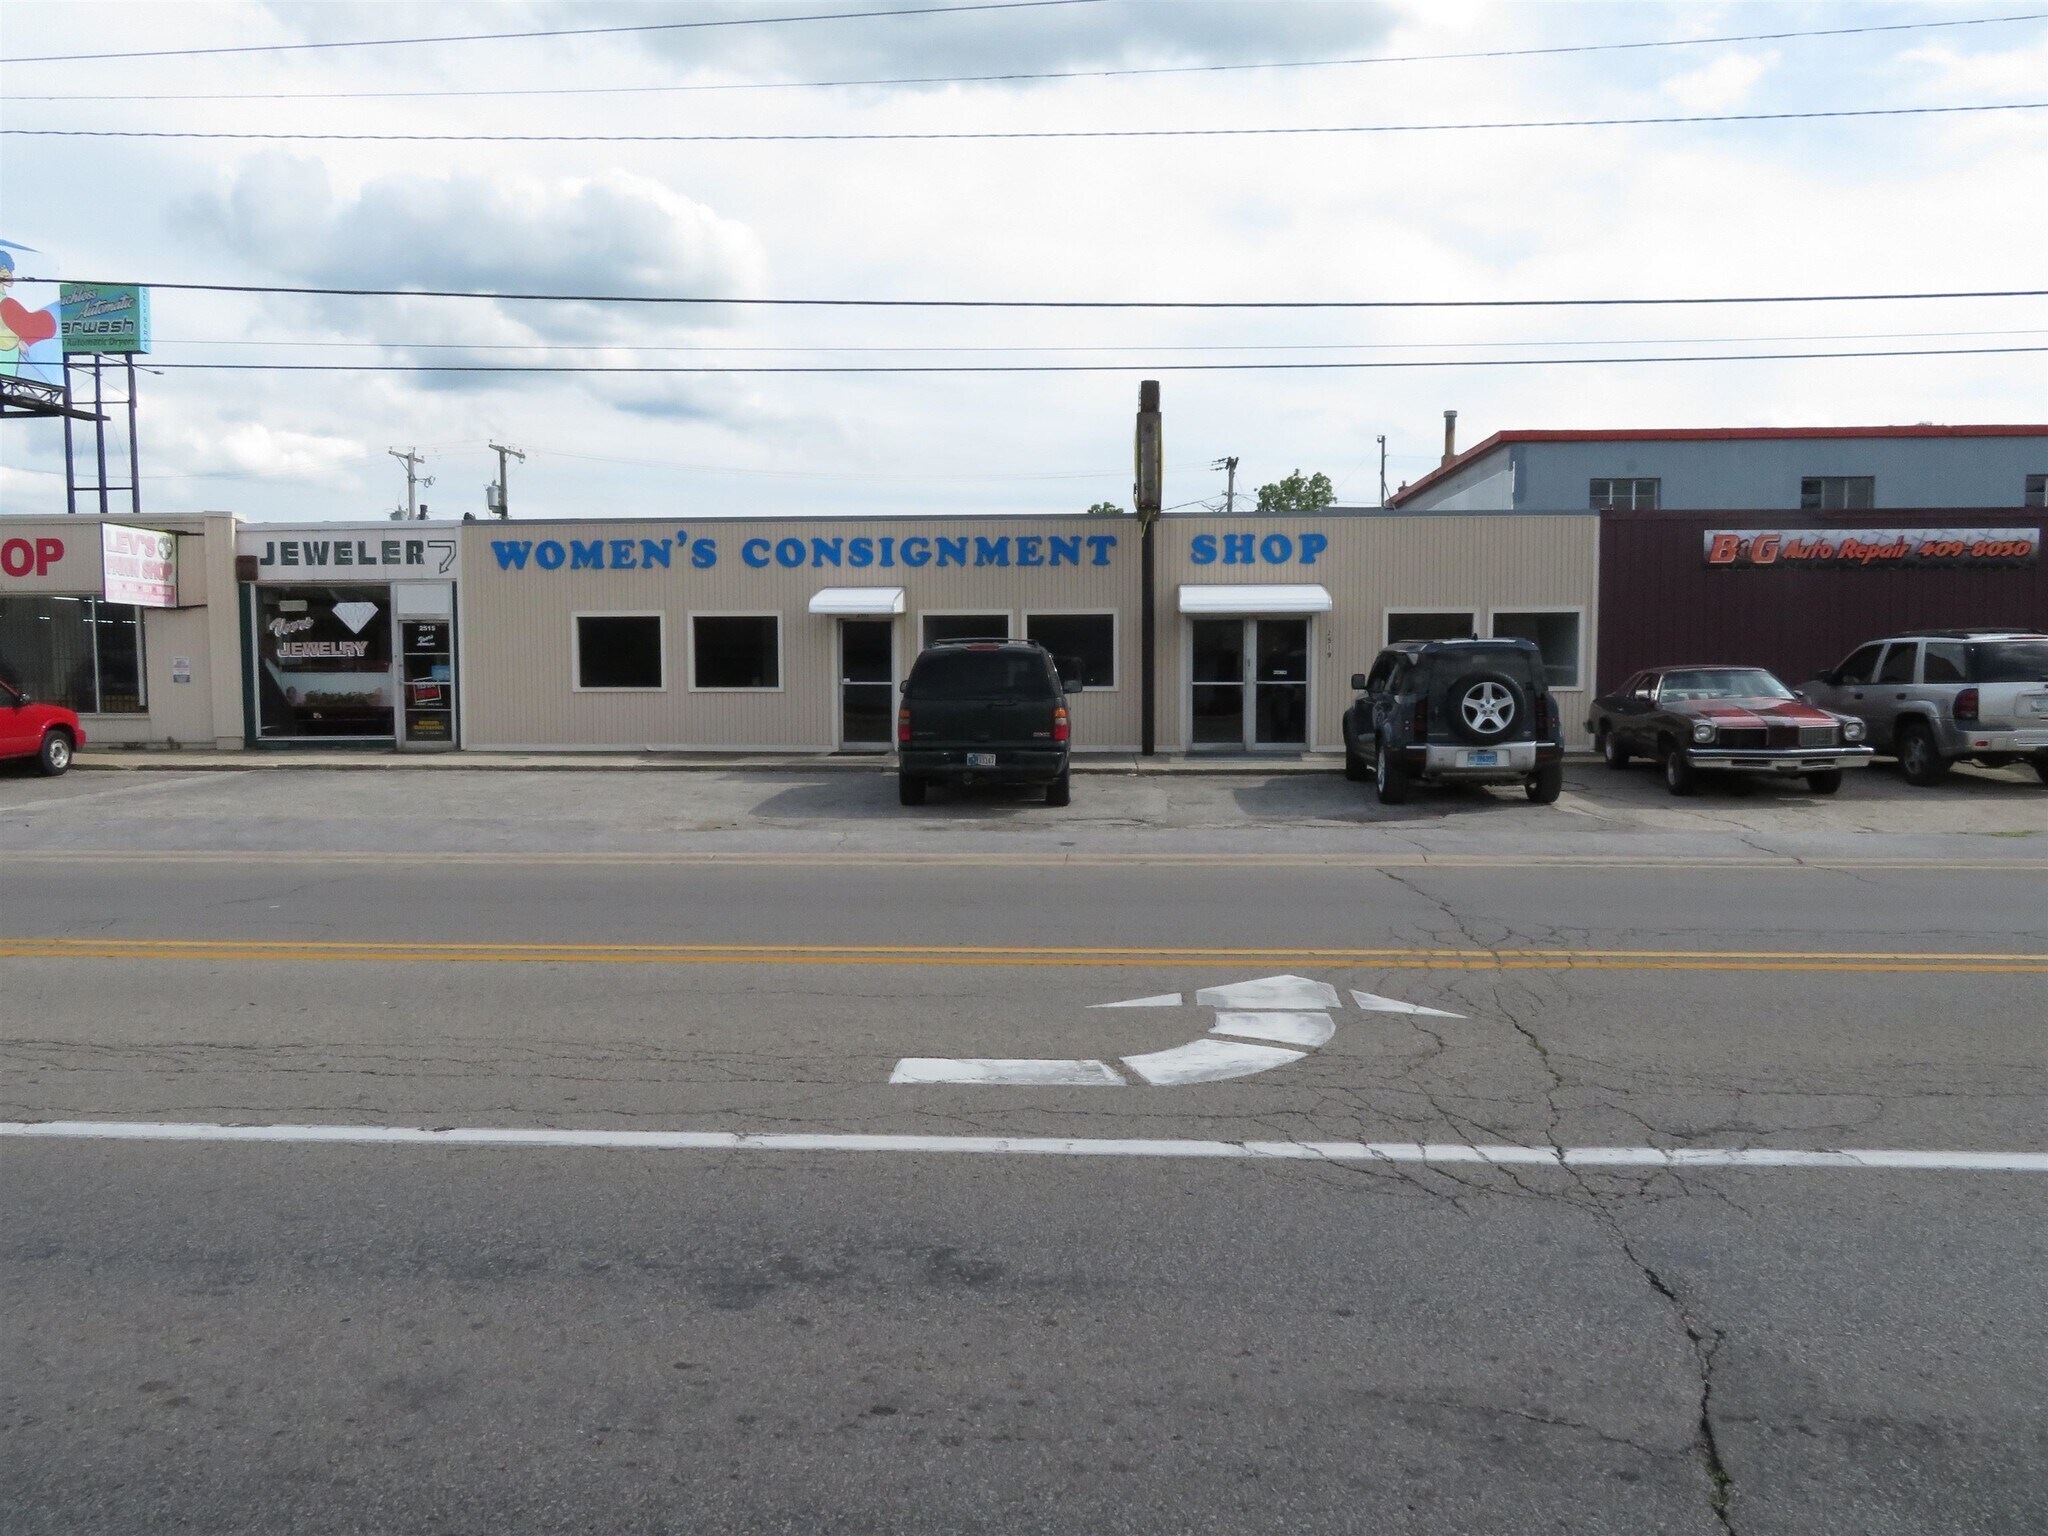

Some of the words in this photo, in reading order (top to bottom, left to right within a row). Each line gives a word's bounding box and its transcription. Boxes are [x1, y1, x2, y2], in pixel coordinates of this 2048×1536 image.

[75, 293, 136, 319] Automatic
[105, 529, 156, 557] LEV'S
[260, 540, 424, 566] JEWELER
[492, 531, 717, 569] WOMEN'S
[742, 536, 1116, 567] CONSIGNMENT
[1191, 533, 1328, 564] SHOP
[1783, 538, 1834, 559] Auto
[1838, 536, 1911, 565] Repair
[1, 538, 64, 577] OP
[143, 560, 173, 581] SHOP
[277, 641, 369, 657] JEWELRY
